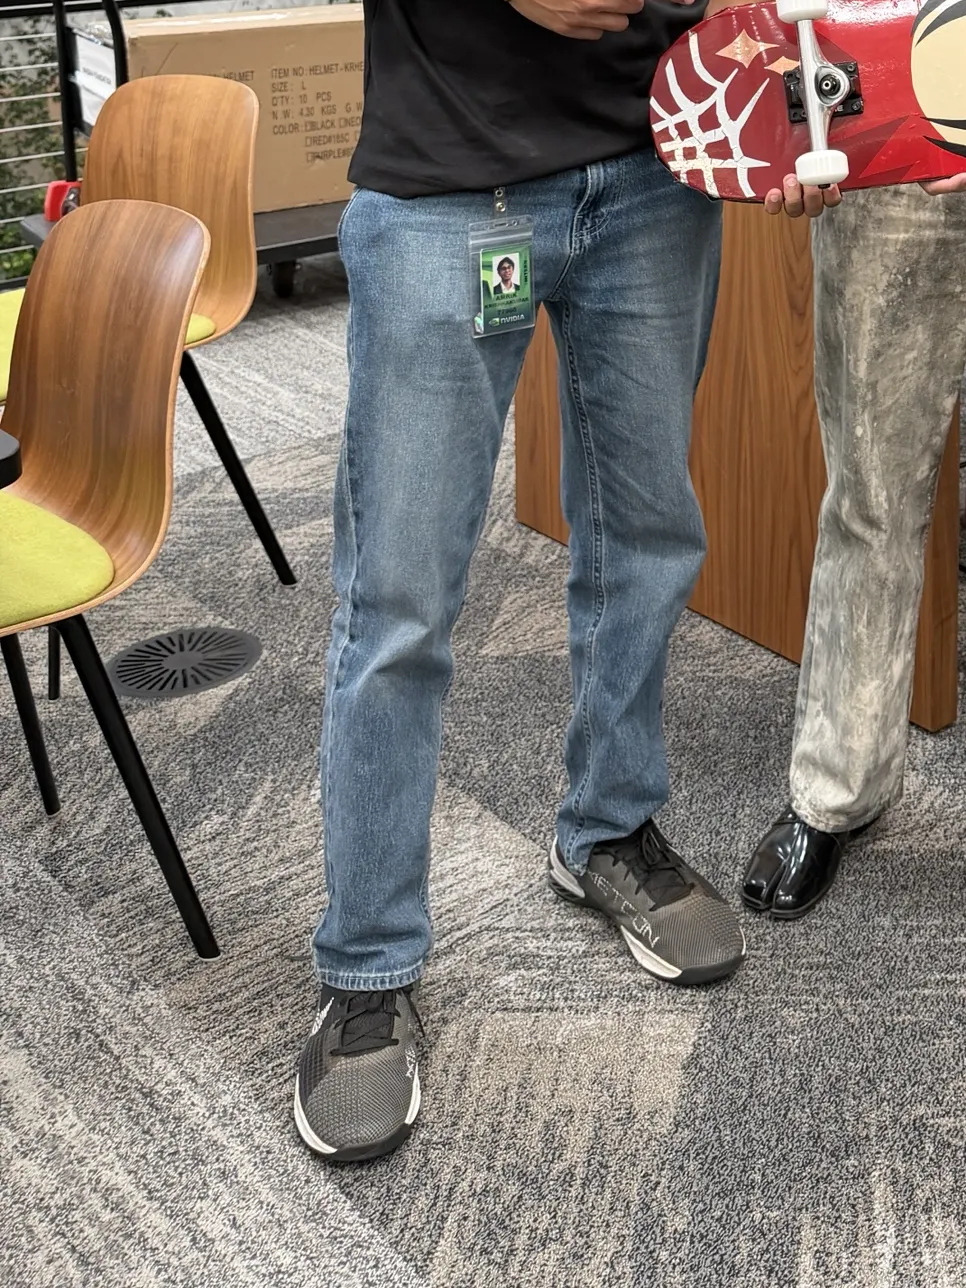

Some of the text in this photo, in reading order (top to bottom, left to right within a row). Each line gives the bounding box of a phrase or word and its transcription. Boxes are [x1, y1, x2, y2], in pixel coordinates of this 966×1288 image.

[271, 67, 290, 80] ITEM
[301, 80, 307, 91] L
[299, 93, 308, 105] 10
[316, 91, 332, 103] PCS
[320, 104, 337, 117] KGS
